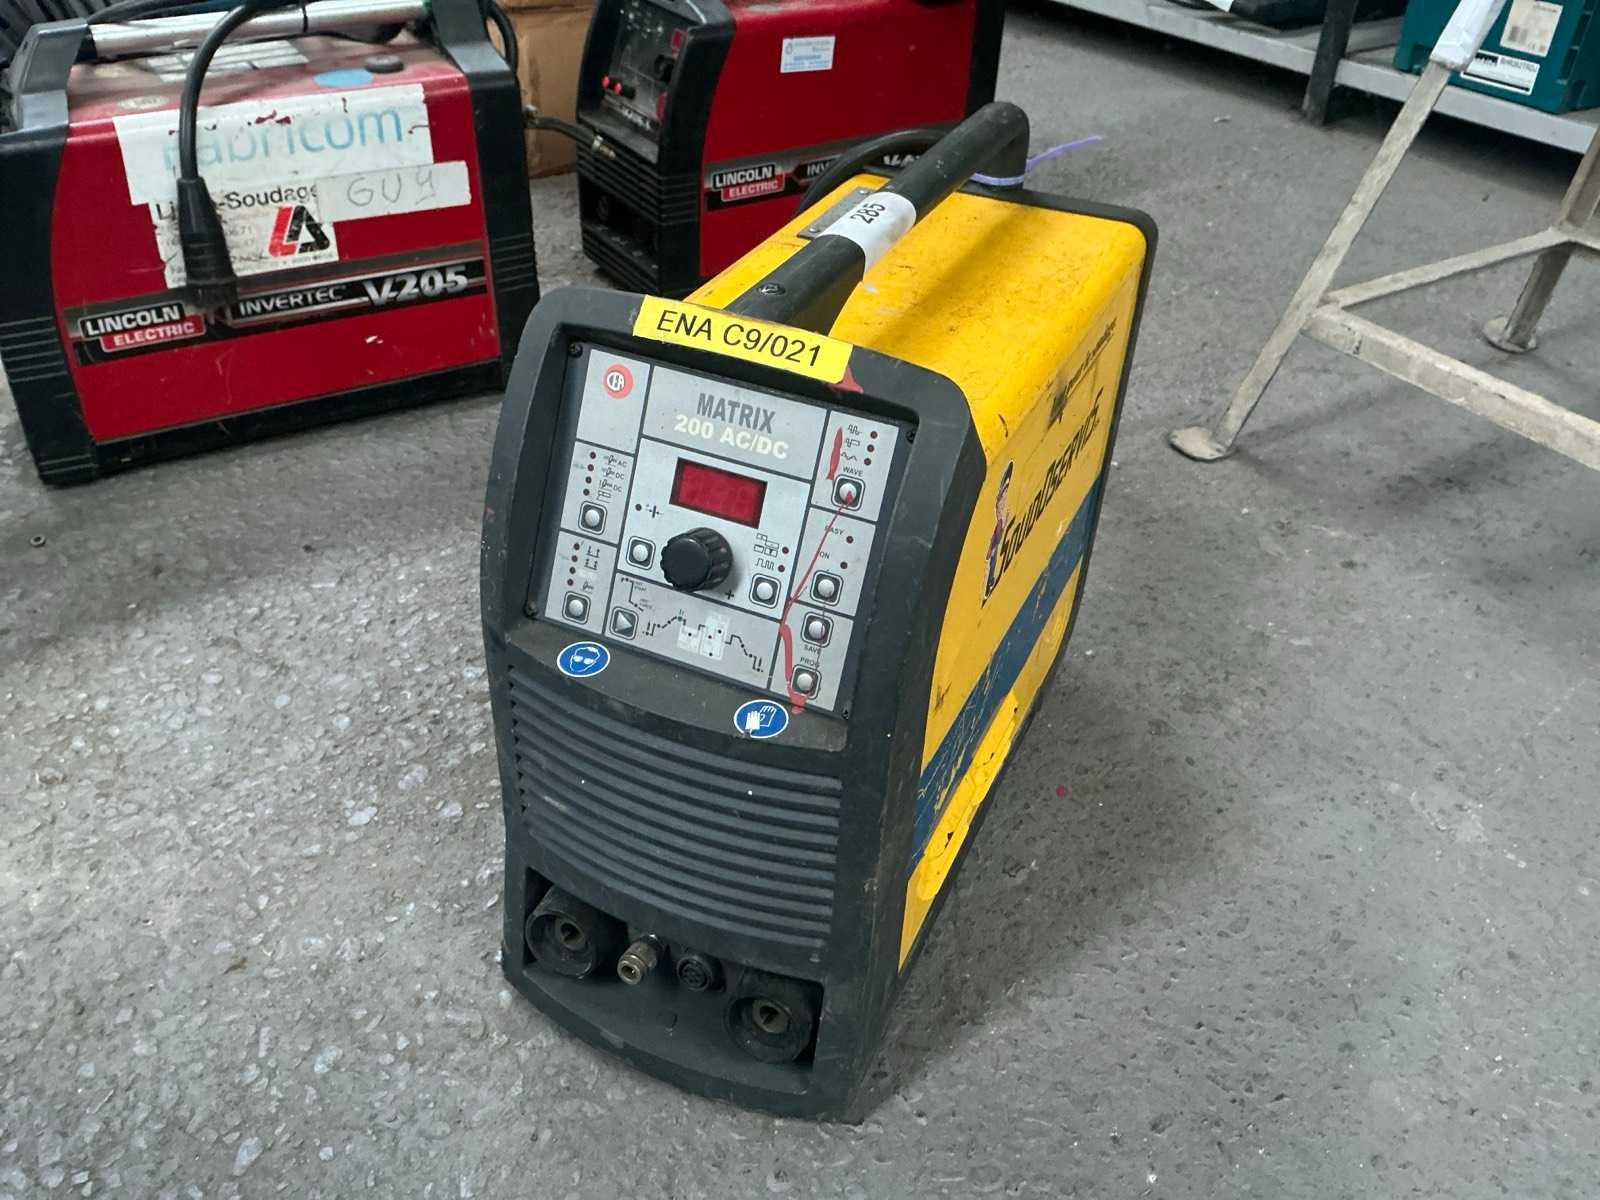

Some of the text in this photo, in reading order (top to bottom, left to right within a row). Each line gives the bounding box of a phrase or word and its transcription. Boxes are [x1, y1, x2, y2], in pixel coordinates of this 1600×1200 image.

[163, 108, 404, 170] abricom
[715, 166, 773, 187] LINCOLN
[729, 180, 778, 198] ELECTRIC
[850, 203, 886, 224] 285
[239, 286, 344, 317] INVERTEC
[85, 305, 180, 336] LINCOLN
[113, 321, 195, 347] ELECTRIC
[657, 310, 821, 366] ENA C9/021
[697, 393, 776, 434] MATRIX
[674, 414, 789, 459] 200 AC/DC
[843, 466, 864, 477] WAVE
